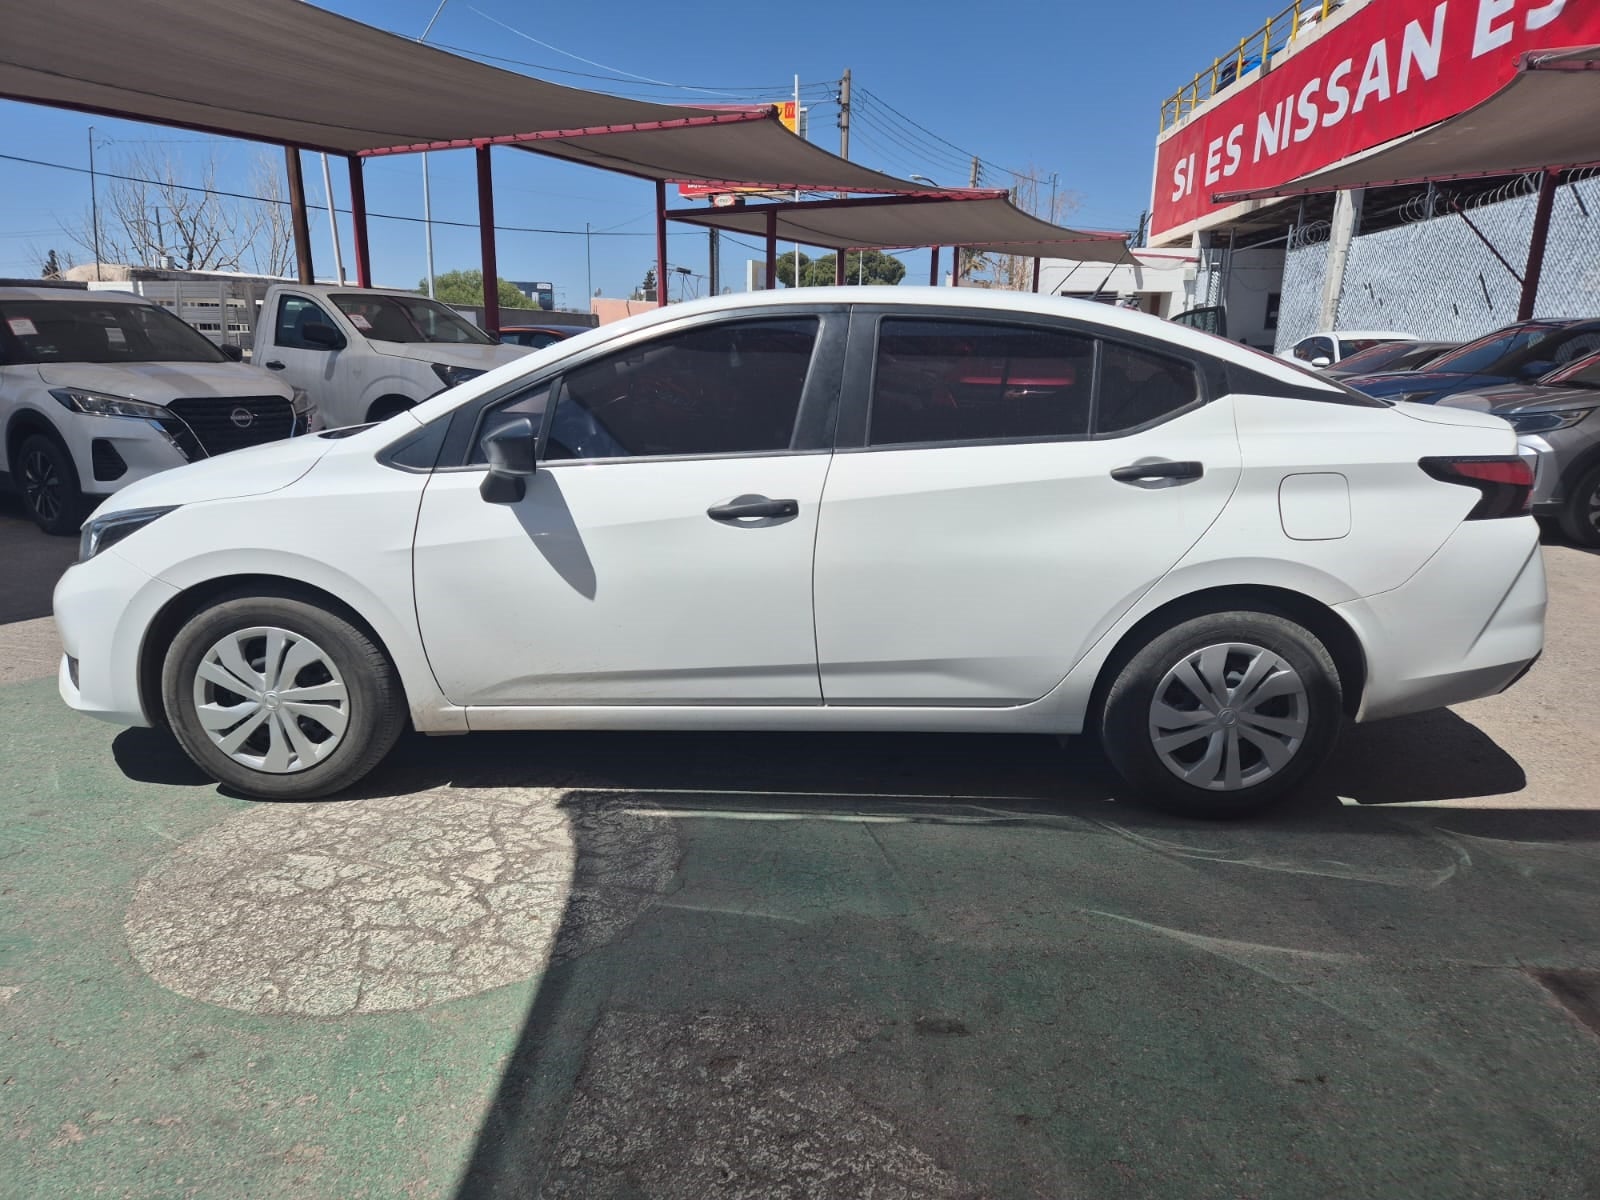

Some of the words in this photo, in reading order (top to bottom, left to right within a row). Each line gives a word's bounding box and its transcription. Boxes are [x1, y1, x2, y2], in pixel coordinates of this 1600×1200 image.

[1172, 152, 1196, 203] SI
[1204, 123, 1244, 187] ES
[1253, 1, 1447, 163] NISSAN
